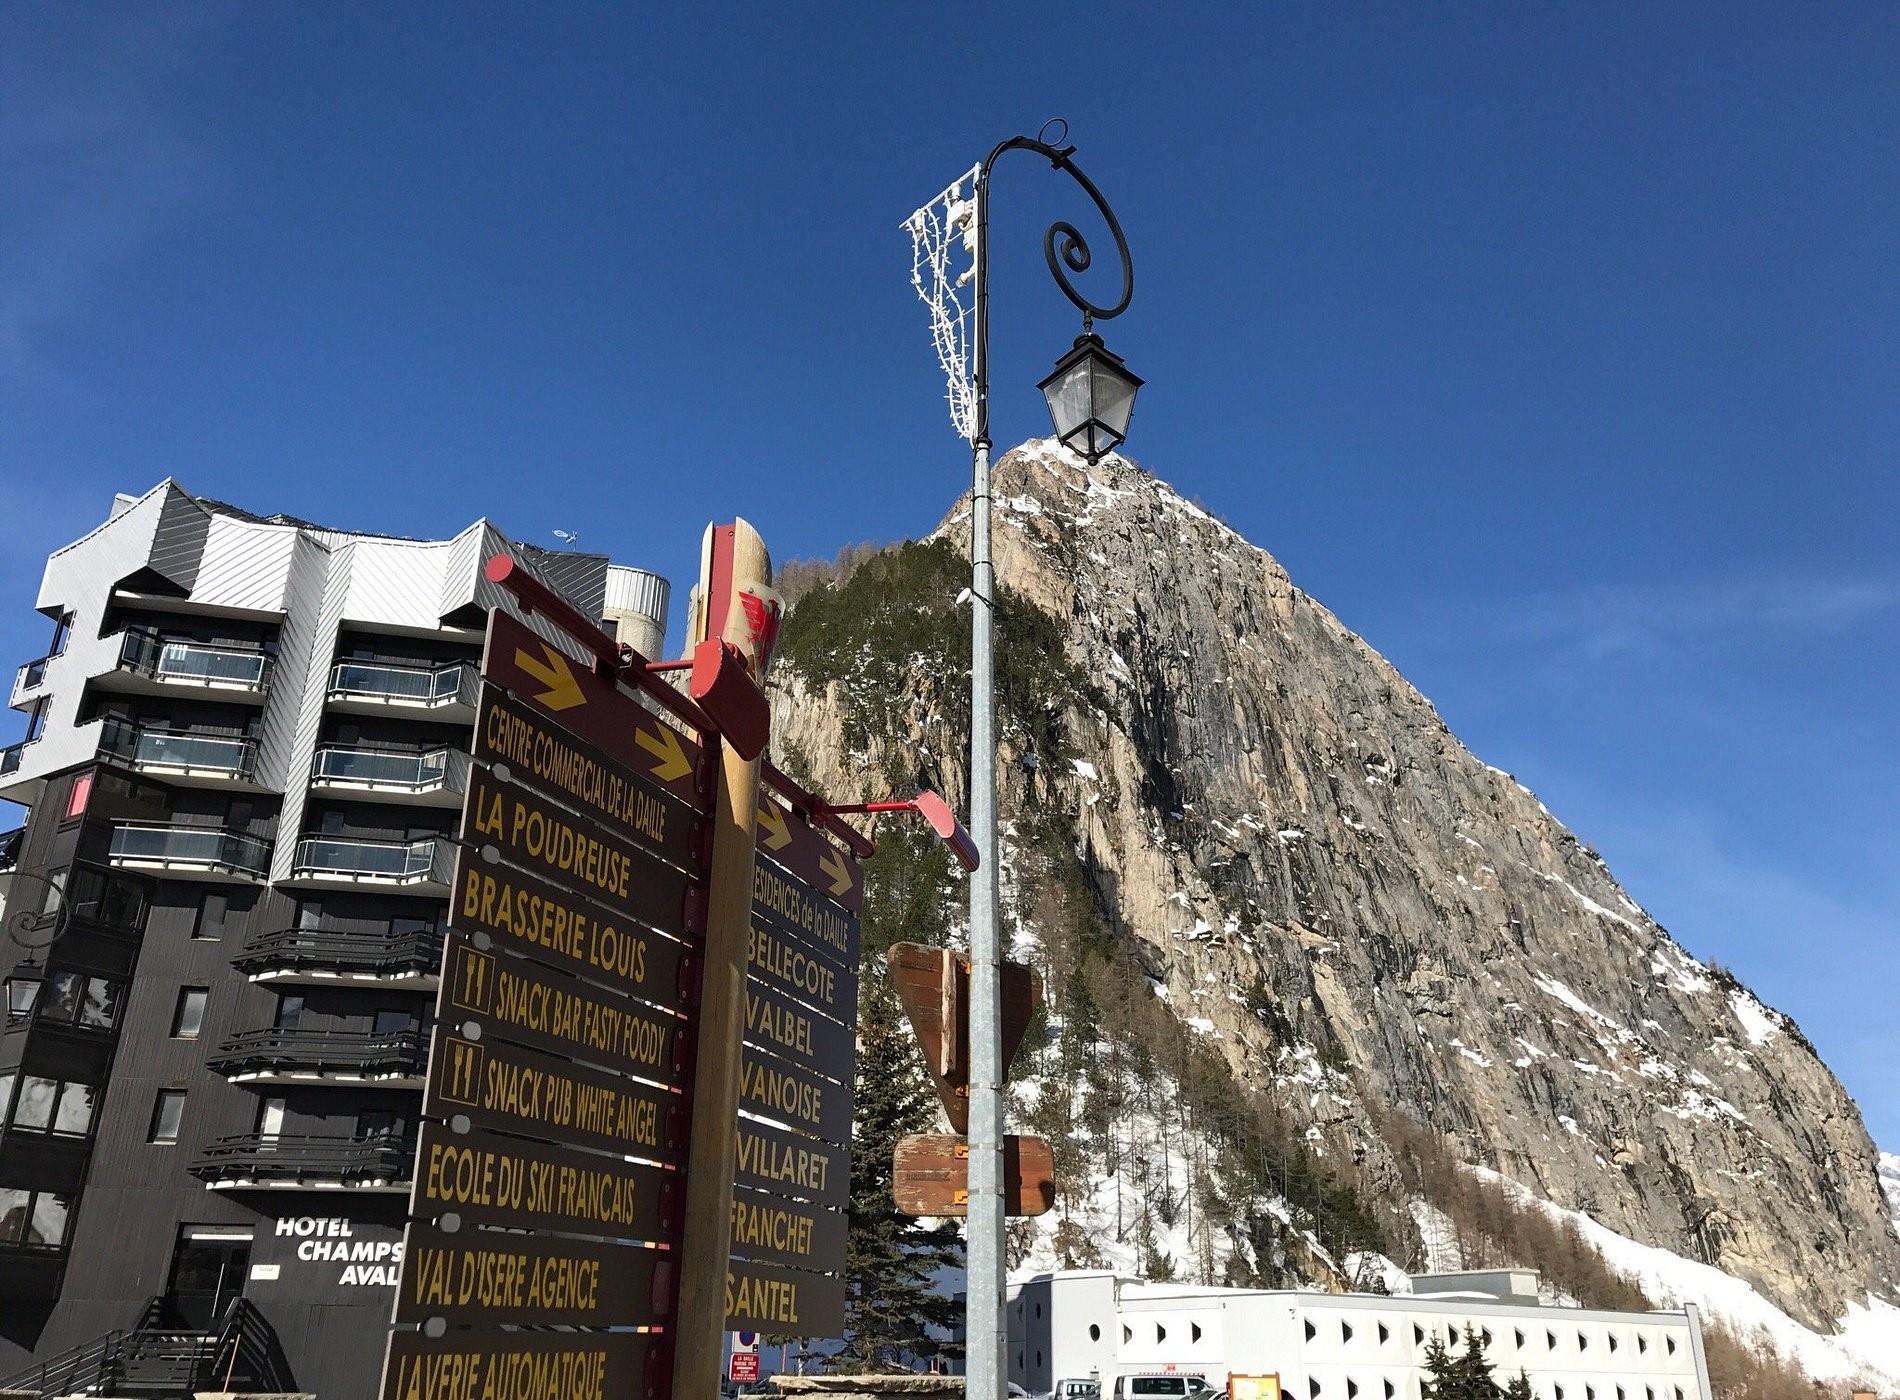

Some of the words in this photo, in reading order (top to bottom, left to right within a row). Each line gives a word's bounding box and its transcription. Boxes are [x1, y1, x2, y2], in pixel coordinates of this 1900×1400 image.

[488, 704, 533, 768] CENTRE
[534, 731, 606, 810] COMMERCIAL
[607, 773, 622, 818] DE
[622, 782, 634, 826] LA
[636, 790, 666, 843] DAILLE
[475, 784, 503, 841] LA
[511, 802, 632, 898] POUDREUSE
[463, 868, 585, 960] BRASSERIE
[590, 921, 647, 984] LOUIS
[753, 864, 800, 924] ESIDENCES
[802, 896, 813, 931] de
[814, 902, 822, 937] la
[824, 909, 848, 953] DAILLE
[748, 926, 835, 1004] BELLECOTE
[496, 971, 552, 1033] SNACK
[552, 990, 582, 1043] BAR
[583, 1000, 621, 1050] FASTY
[622, 1014, 666, 1067] FOODY
[745, 991, 814, 1056] VALBEL
[485, 1058, 544, 1119] SNACK
[545, 1076, 572, 1127] PUB
[575, 1082, 615, 1135] WHITE
[616, 1095, 657, 1146] ANGEL
[740, 1061, 821, 1124] VANOISE
[427, 1144, 494, 1205] ECOLE
[497, 1156, 524, 1210] DU
[527, 1161, 555, 1213] SKI
[557, 1166, 635, 1225] FRANCAIS
[736, 1131, 829, 1191] VILLARET
[275, 1217, 353, 1237] HOTEL
[297, 1240, 403, 1262] CHAMPS
[416, 1248, 454, 1305] VAL
[459, 1251, 527, 1307] D'ISERE
[527, 1256, 599, 1309] AGENCE
[725, 1272, 798, 1323] SANTEL
[482, 1352, 606, 1400] AUTOMATIQUE
